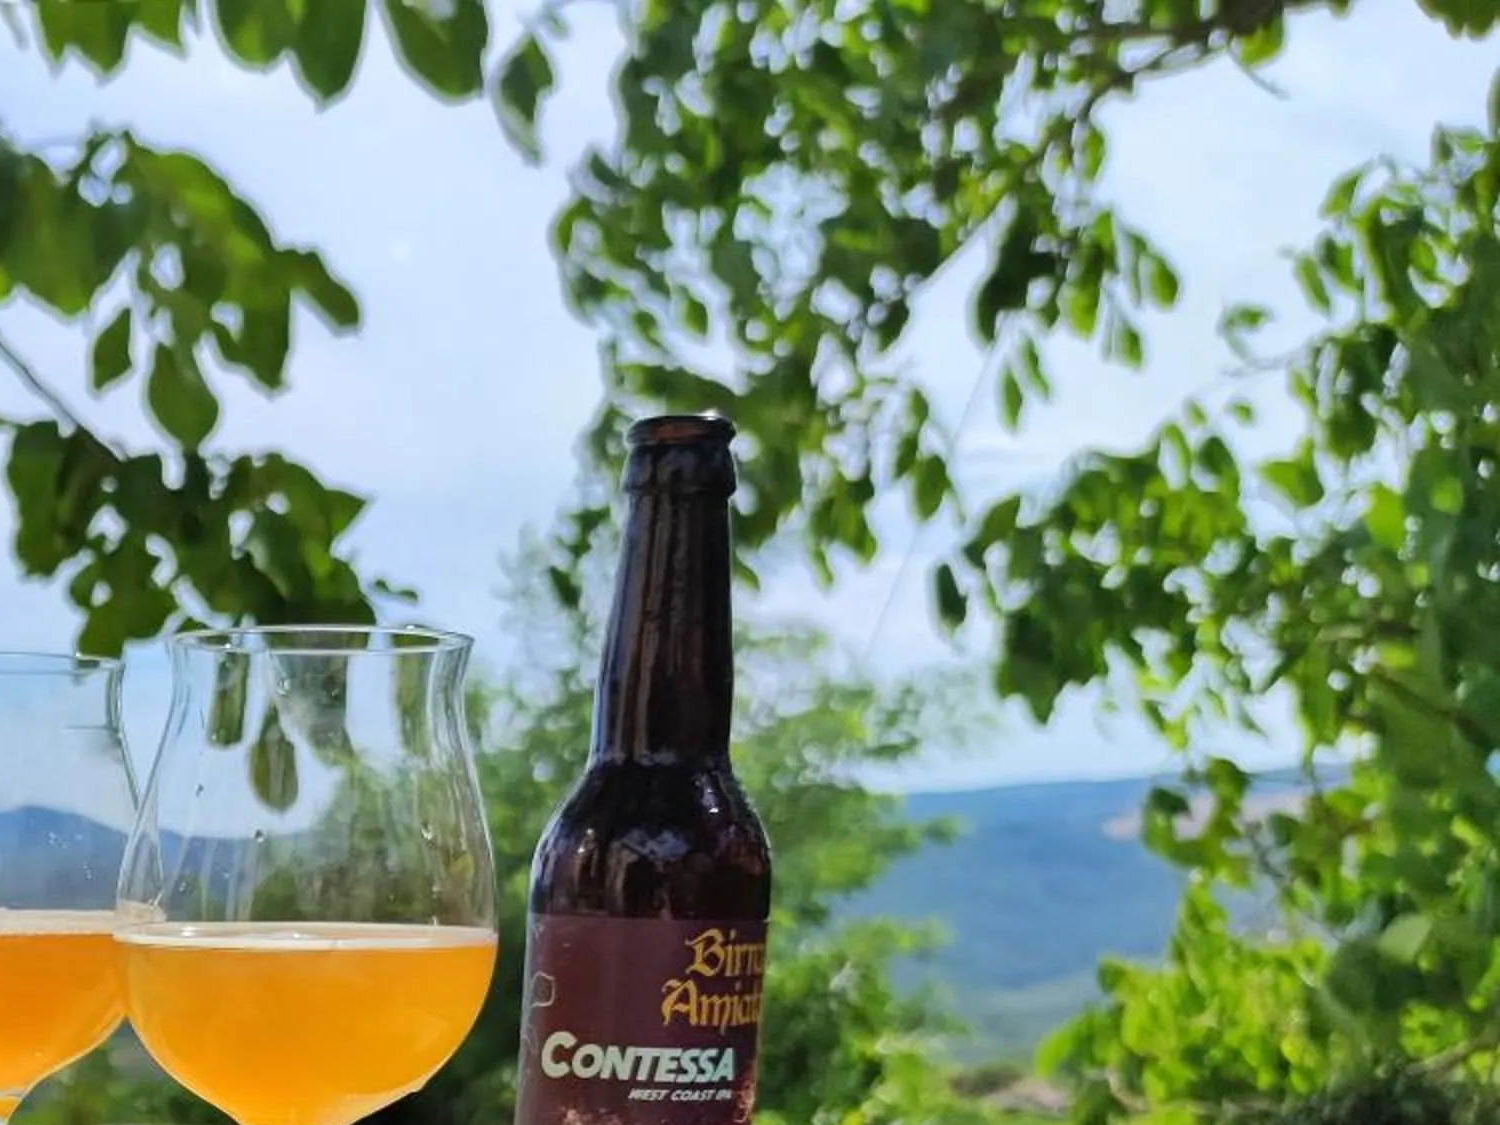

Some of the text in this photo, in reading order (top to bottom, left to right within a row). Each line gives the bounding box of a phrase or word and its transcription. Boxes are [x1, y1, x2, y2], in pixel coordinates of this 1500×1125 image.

[661, 979, 763, 1036] Amiat
[541, 1031, 735, 1083] CONTESSA
[670, 1089, 716, 1101] COAST
